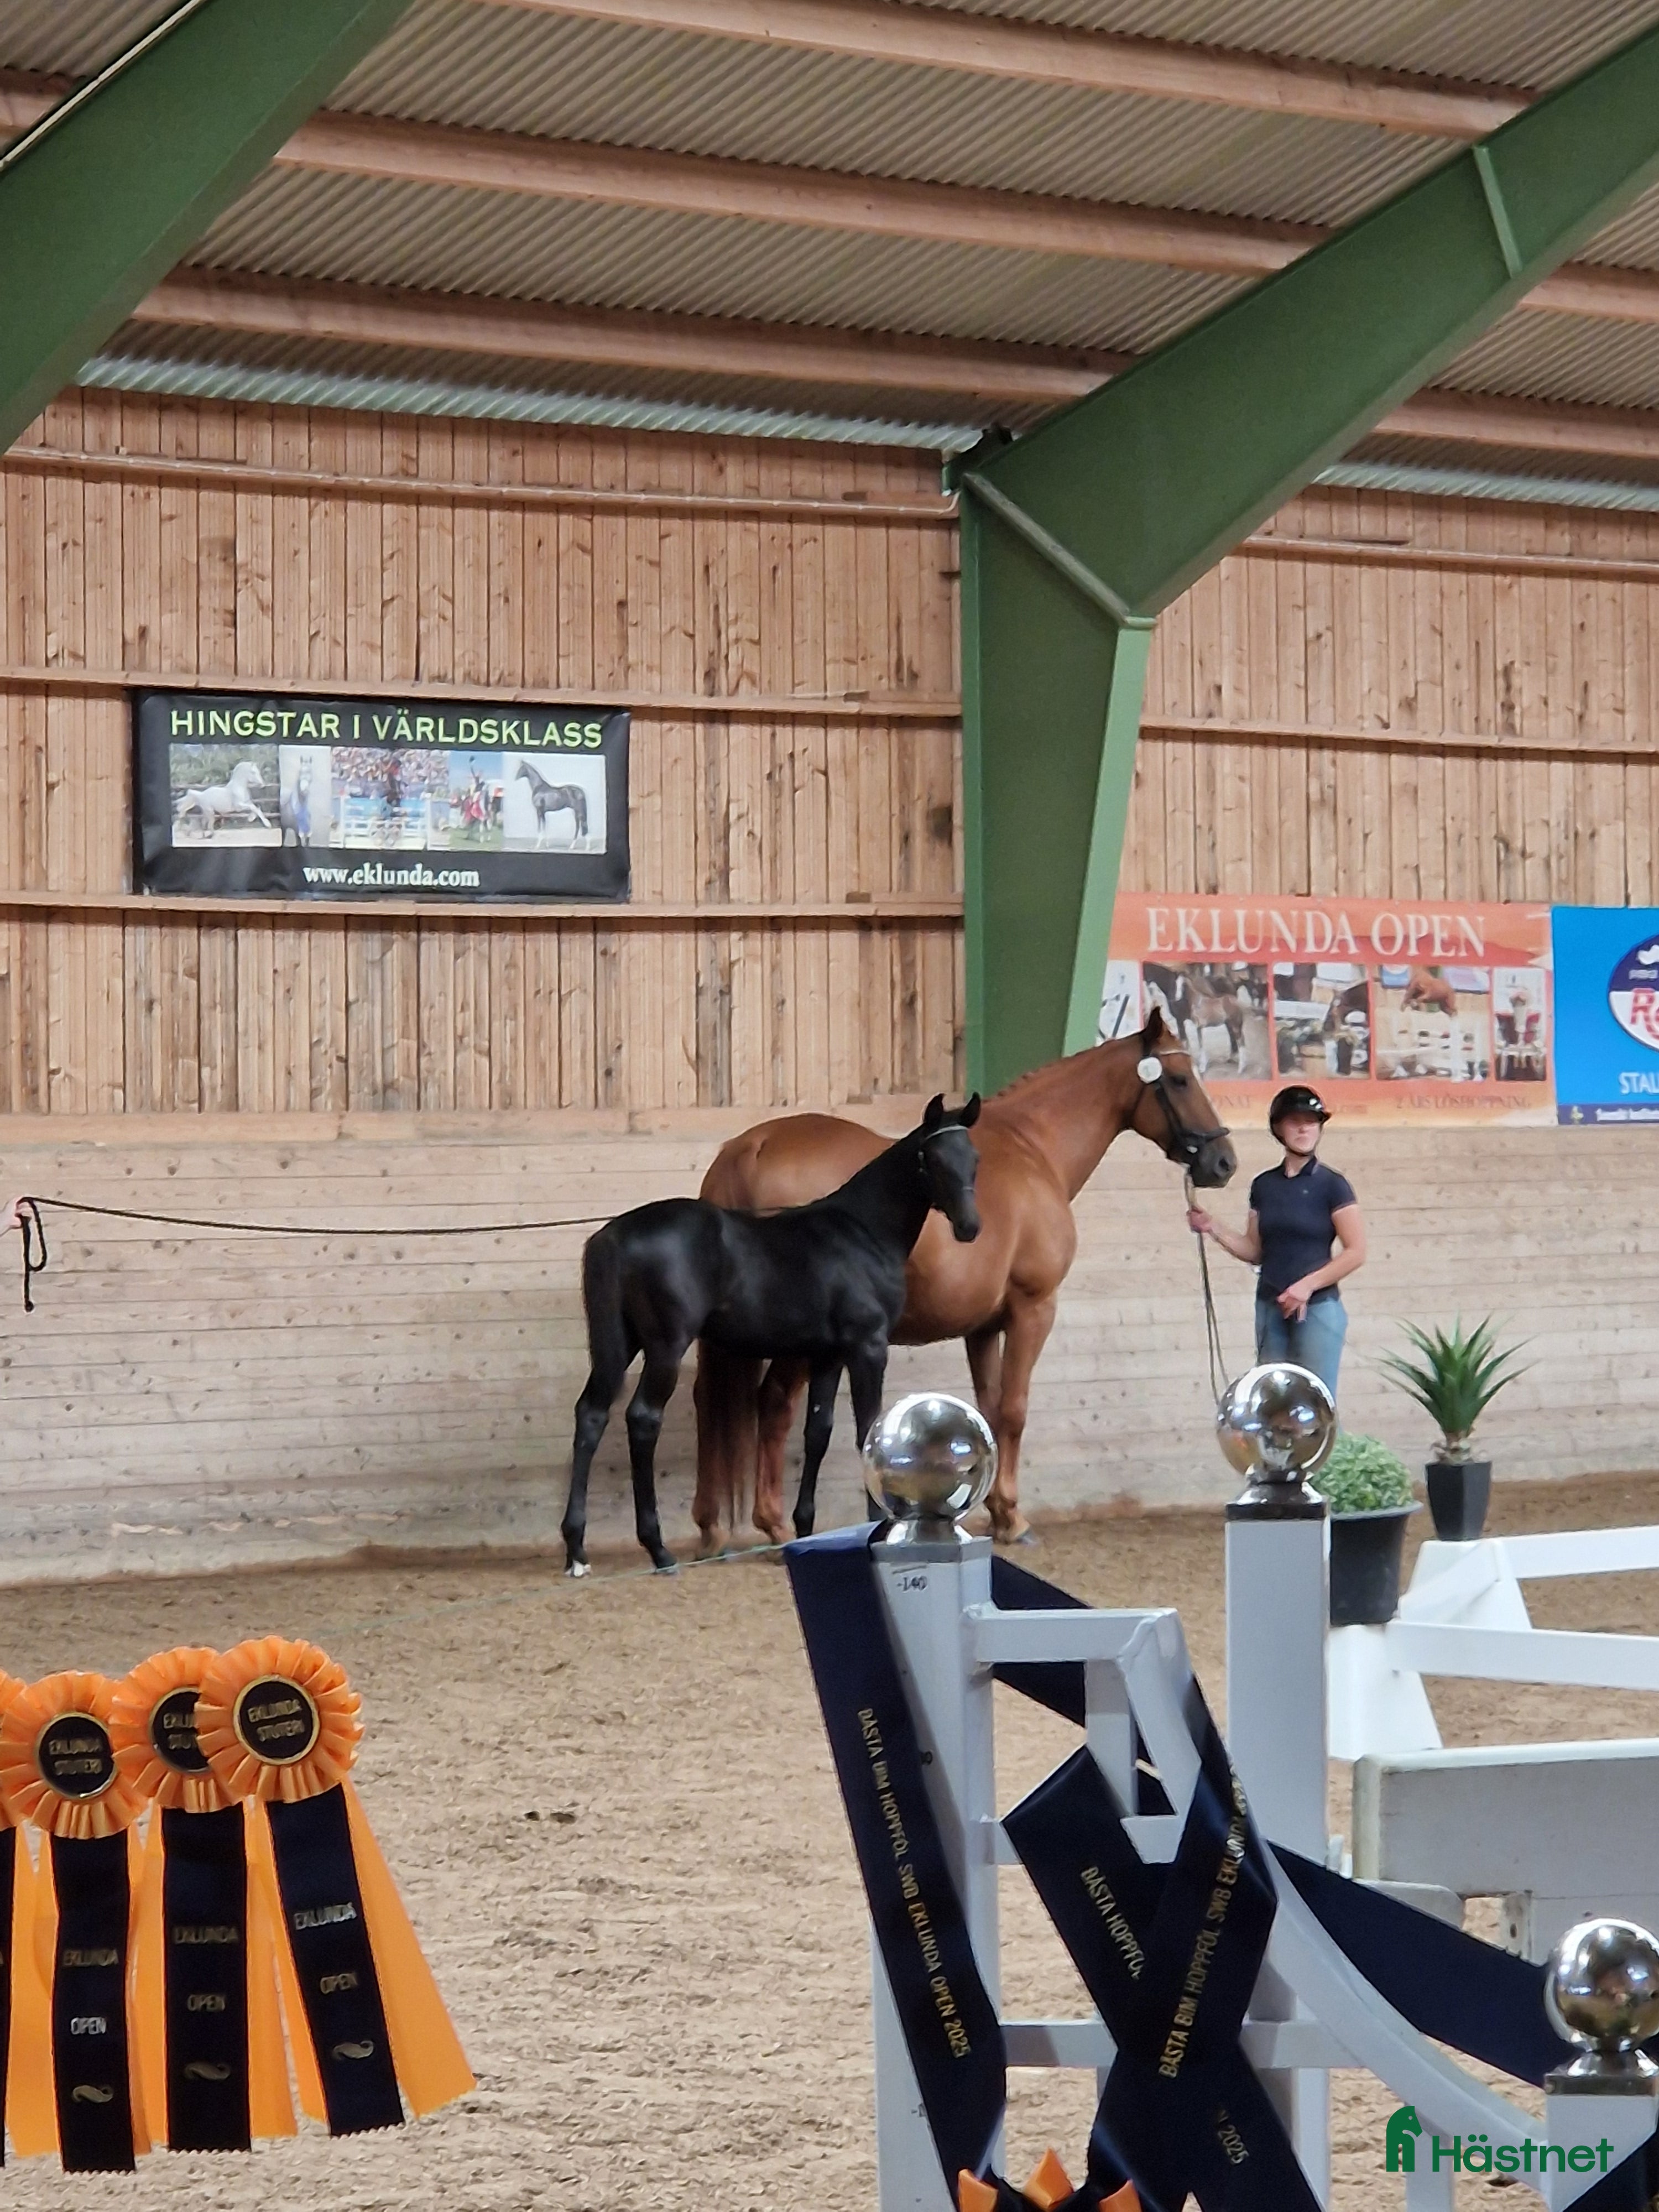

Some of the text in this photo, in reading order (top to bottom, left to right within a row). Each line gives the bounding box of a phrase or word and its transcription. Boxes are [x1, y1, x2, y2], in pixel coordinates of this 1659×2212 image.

[171, 708, 602, 748] HINGSTAR I VÄRLDSKLASS
[302, 862, 480, 887] www.eklunda.com
[1147, 907, 1486, 958] EKLUNDA OPEN
[930, 1975, 957, 2018] OPEN
[70, 2017, 107, 2036] OPEN
